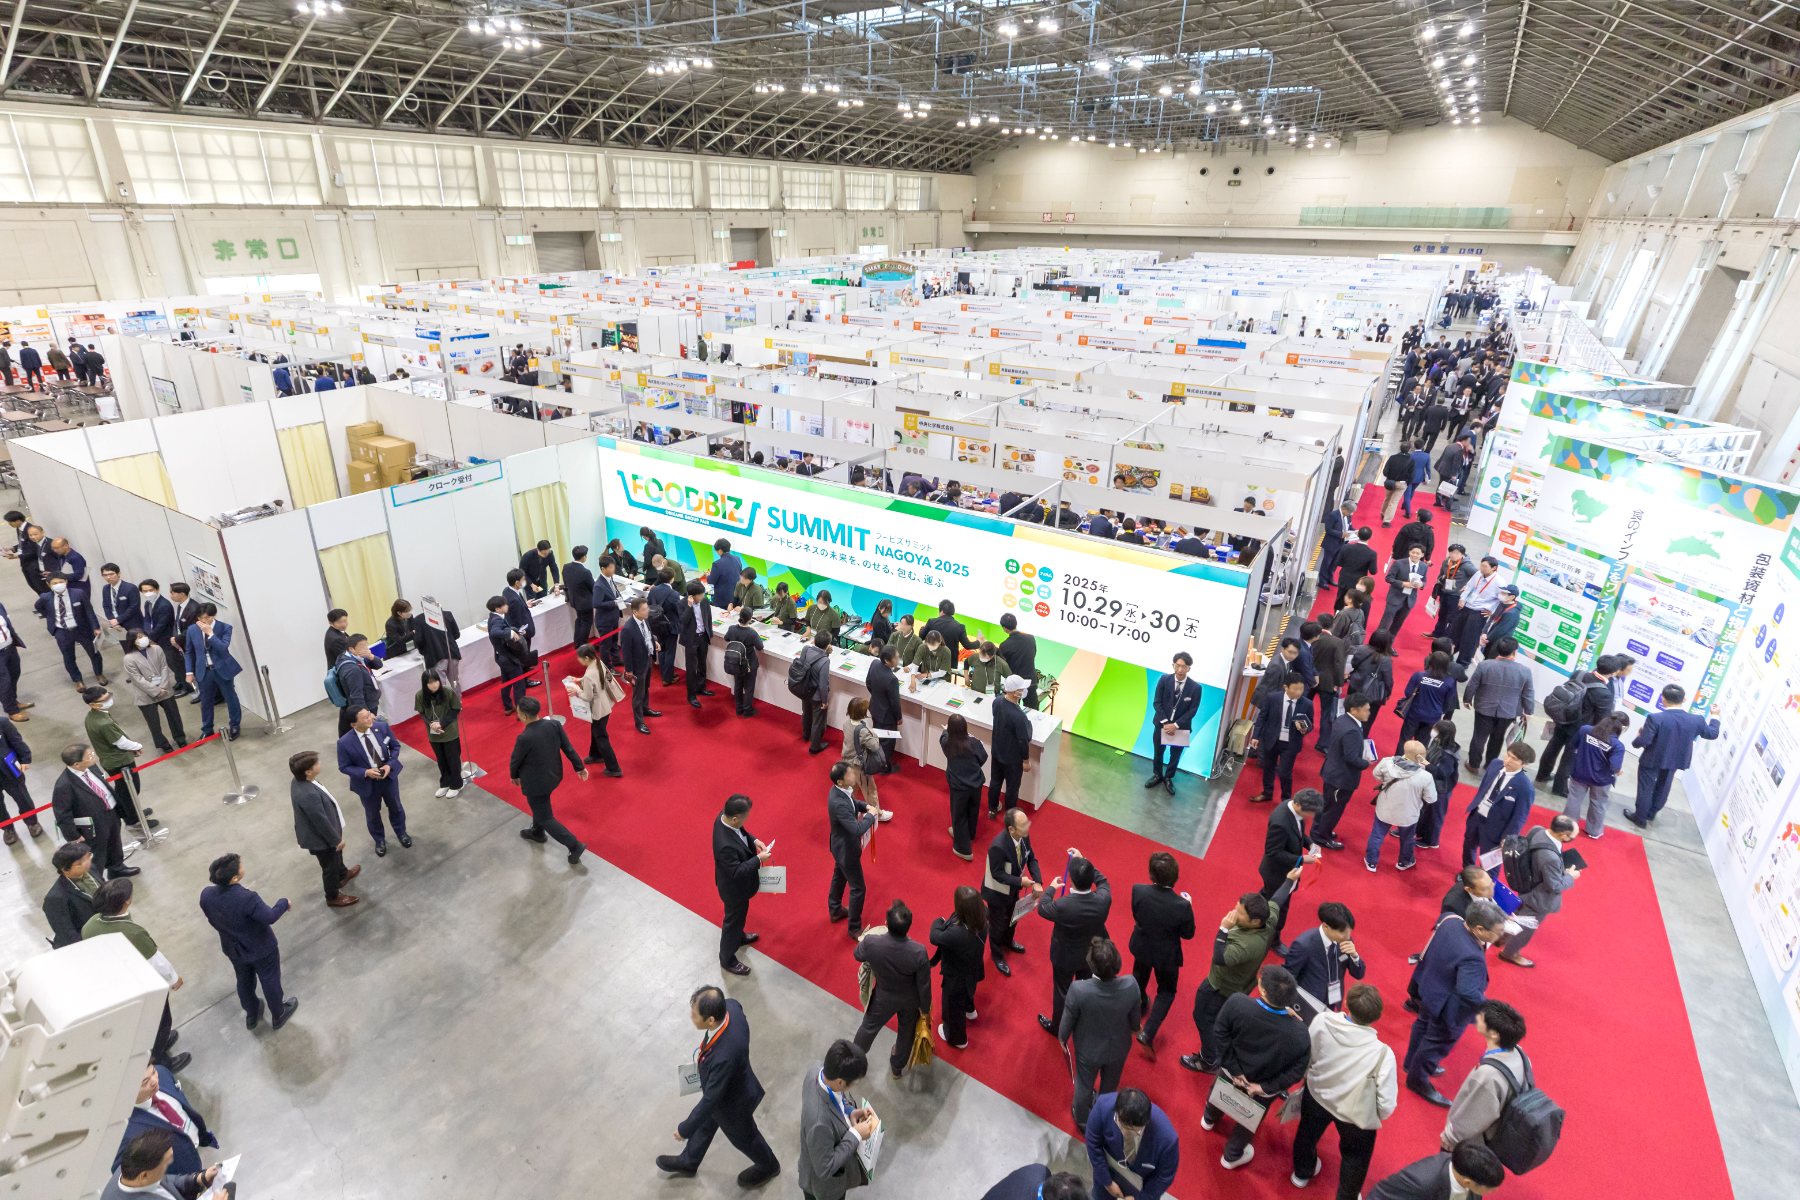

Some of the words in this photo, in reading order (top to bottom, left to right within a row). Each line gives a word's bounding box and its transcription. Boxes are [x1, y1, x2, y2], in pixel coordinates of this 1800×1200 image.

[212, 237, 300, 261] 非常口
[428, 474, 473, 491] クローク受付
[631, 473, 744, 523] FOODBIZ
[767, 506, 871, 552] SUMMIT
[766, 533, 945, 588] フードビジネスの未来を、のせる、包む、運ぶ
[875, 544, 931, 569] NAGOYA
[935, 558, 970, 578] 2025
[1064, 574, 1109, 593] 2025年
[1062, 588, 1123, 618] 10.29
[1150, 610, 1181, 633] 30
